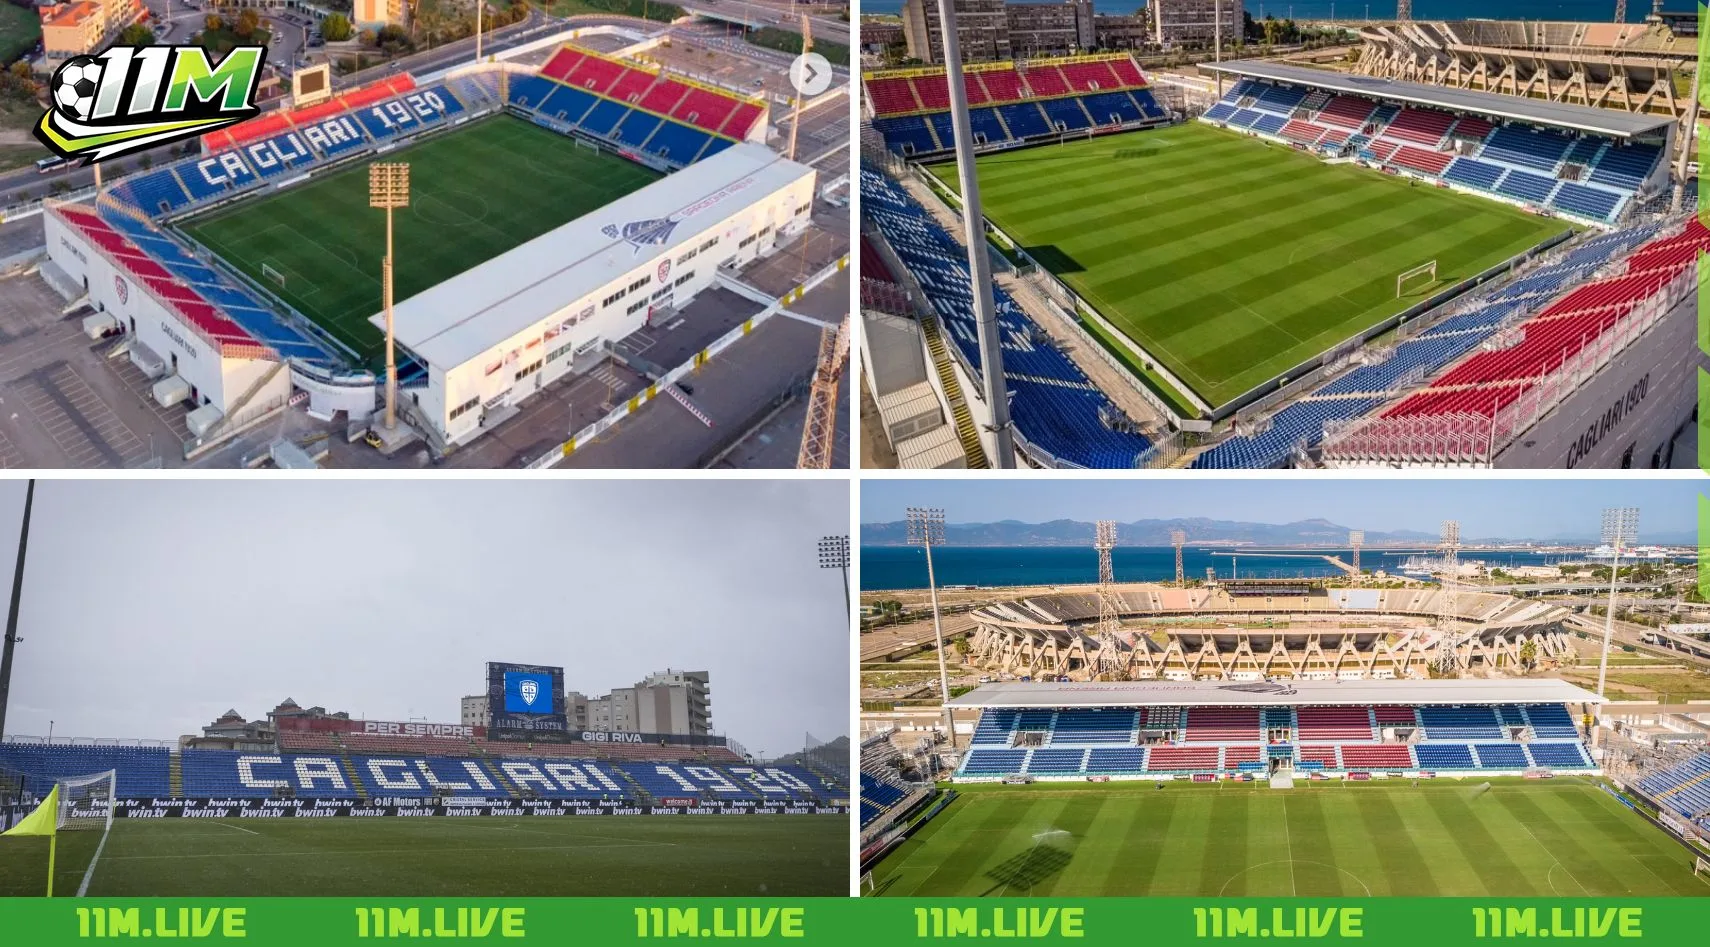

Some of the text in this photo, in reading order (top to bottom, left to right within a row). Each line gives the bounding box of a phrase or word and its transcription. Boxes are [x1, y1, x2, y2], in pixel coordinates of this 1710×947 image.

[197, 91, 445, 186] CAGLIARI 1920
[1567, 373, 1650, 469] CAGLIARI 1920
[364, 721, 474, 736] PER SEMPRE
[496, 719, 563, 730] ALARM SYSTEM
[582, 731, 643, 743] GIGI RIVA
[236, 755, 813, 794] CAGLIARI 1920
[382, 797, 392, 806] AF
[393, 797, 421, 807] Motors
